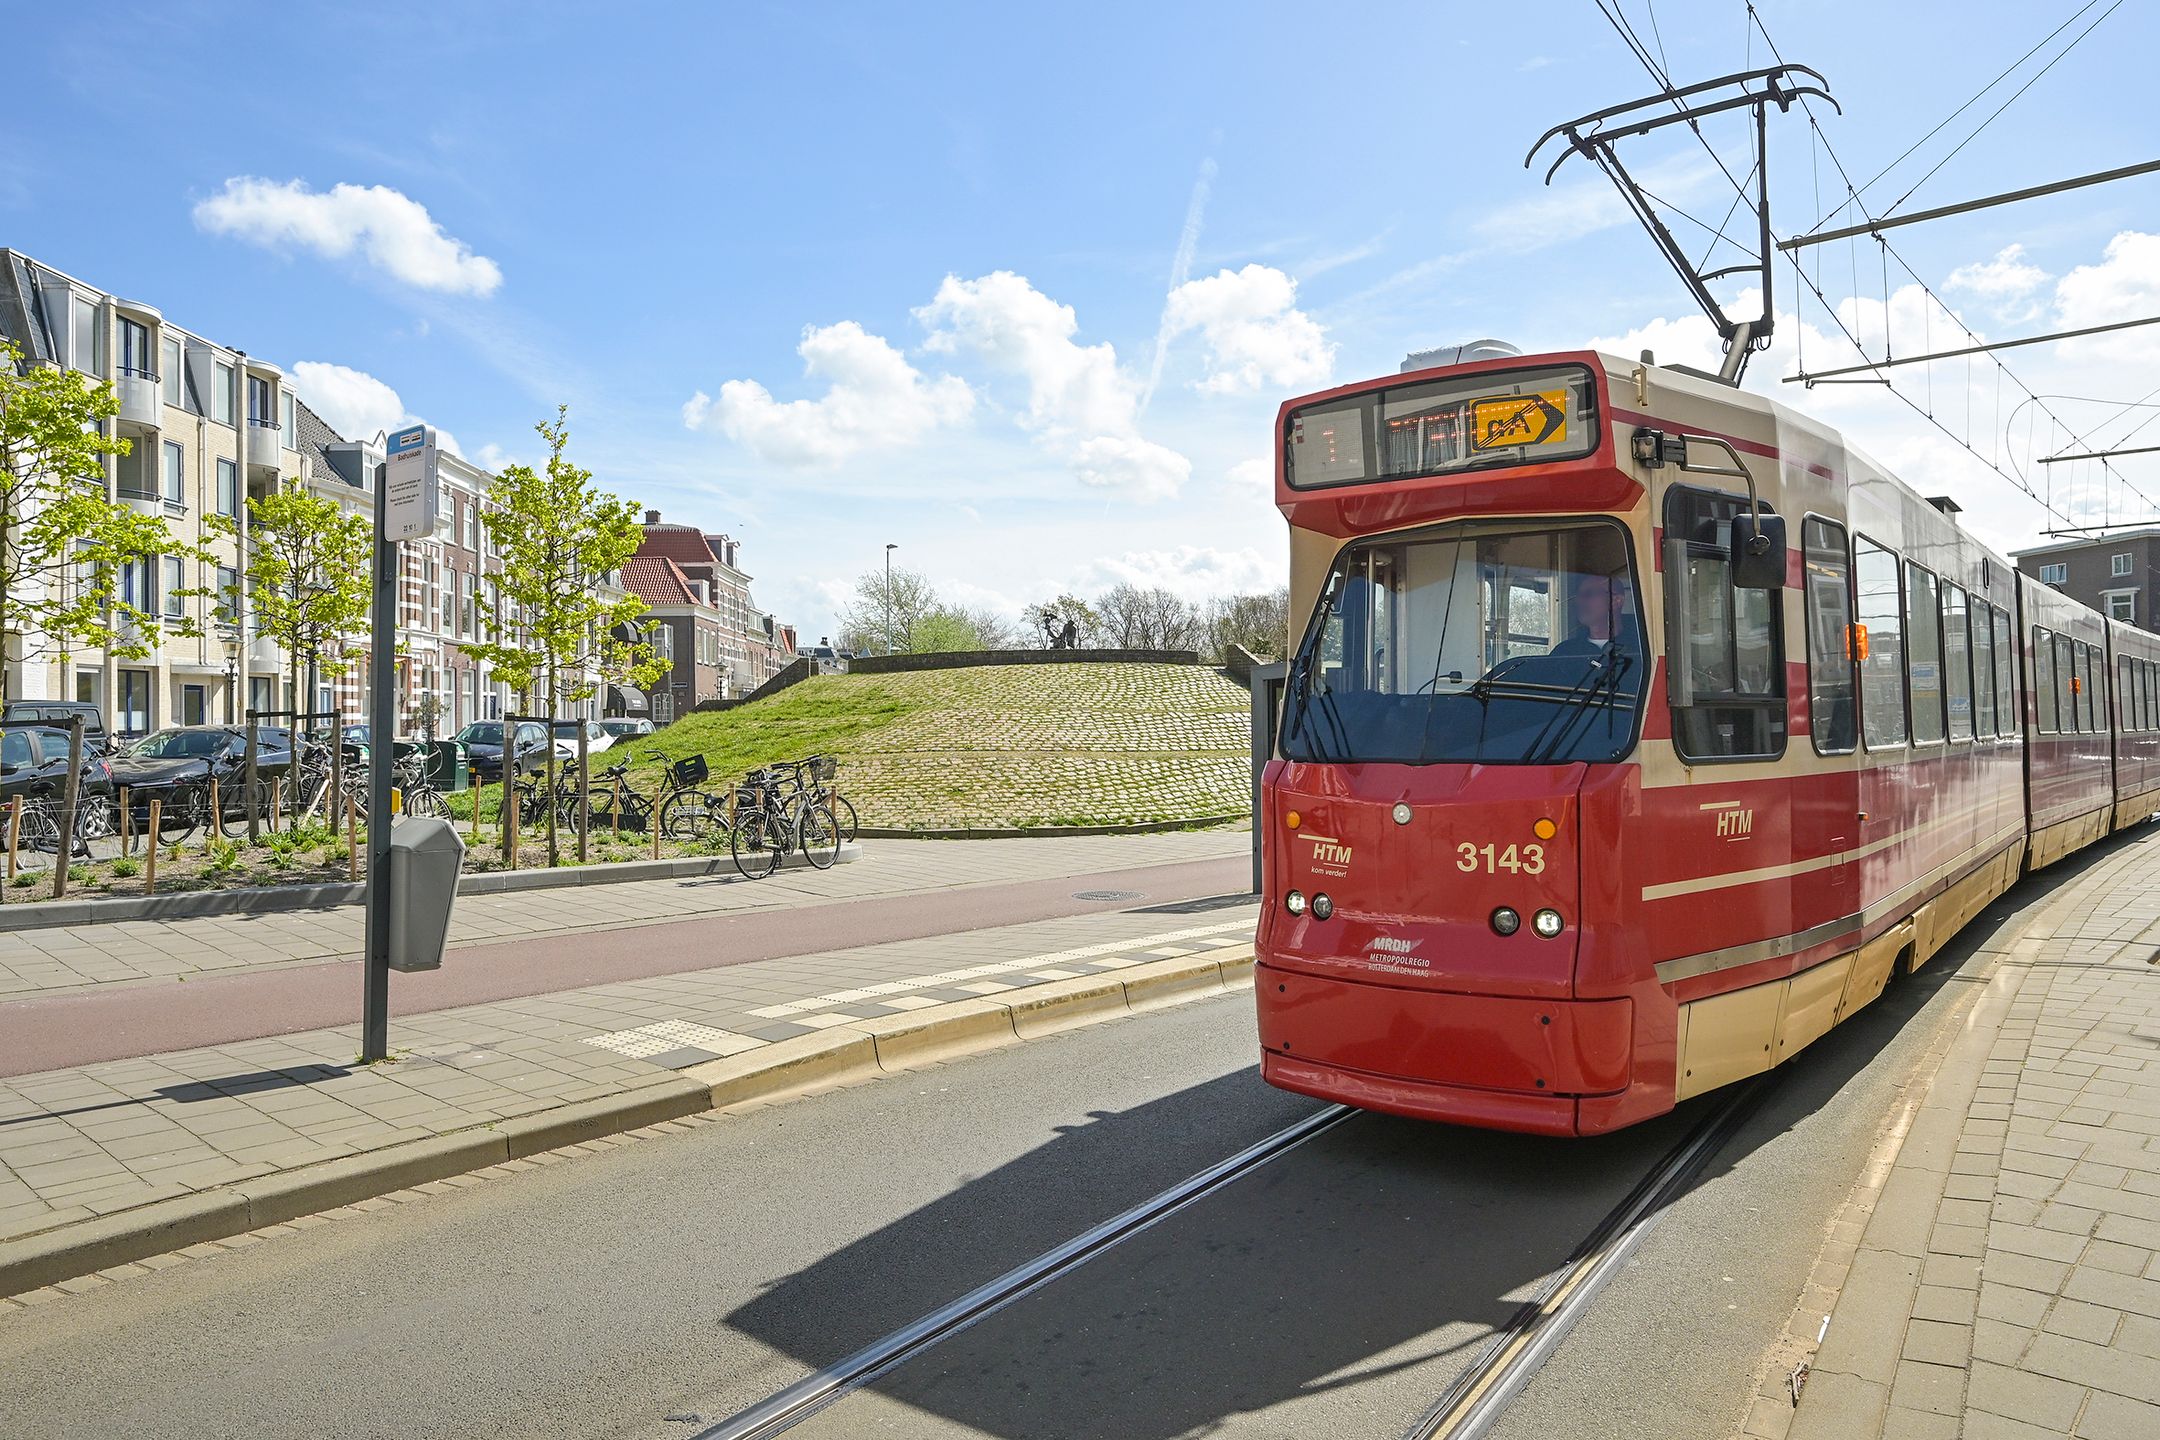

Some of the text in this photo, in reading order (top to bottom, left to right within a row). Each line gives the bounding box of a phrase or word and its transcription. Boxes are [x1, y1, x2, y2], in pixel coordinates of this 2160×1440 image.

[1716, 809, 1753, 837] HTM
[1313, 843, 1352, 863] HTM
[1456, 842, 1546, 875] 3143
[1311, 866, 1324, 875] kom
[1373, 937, 1411, 953] MRDH
[1368, 963, 1400, 973] ROTTERDAM
[1369, 953, 1430, 967] METROPOOLREGIO
